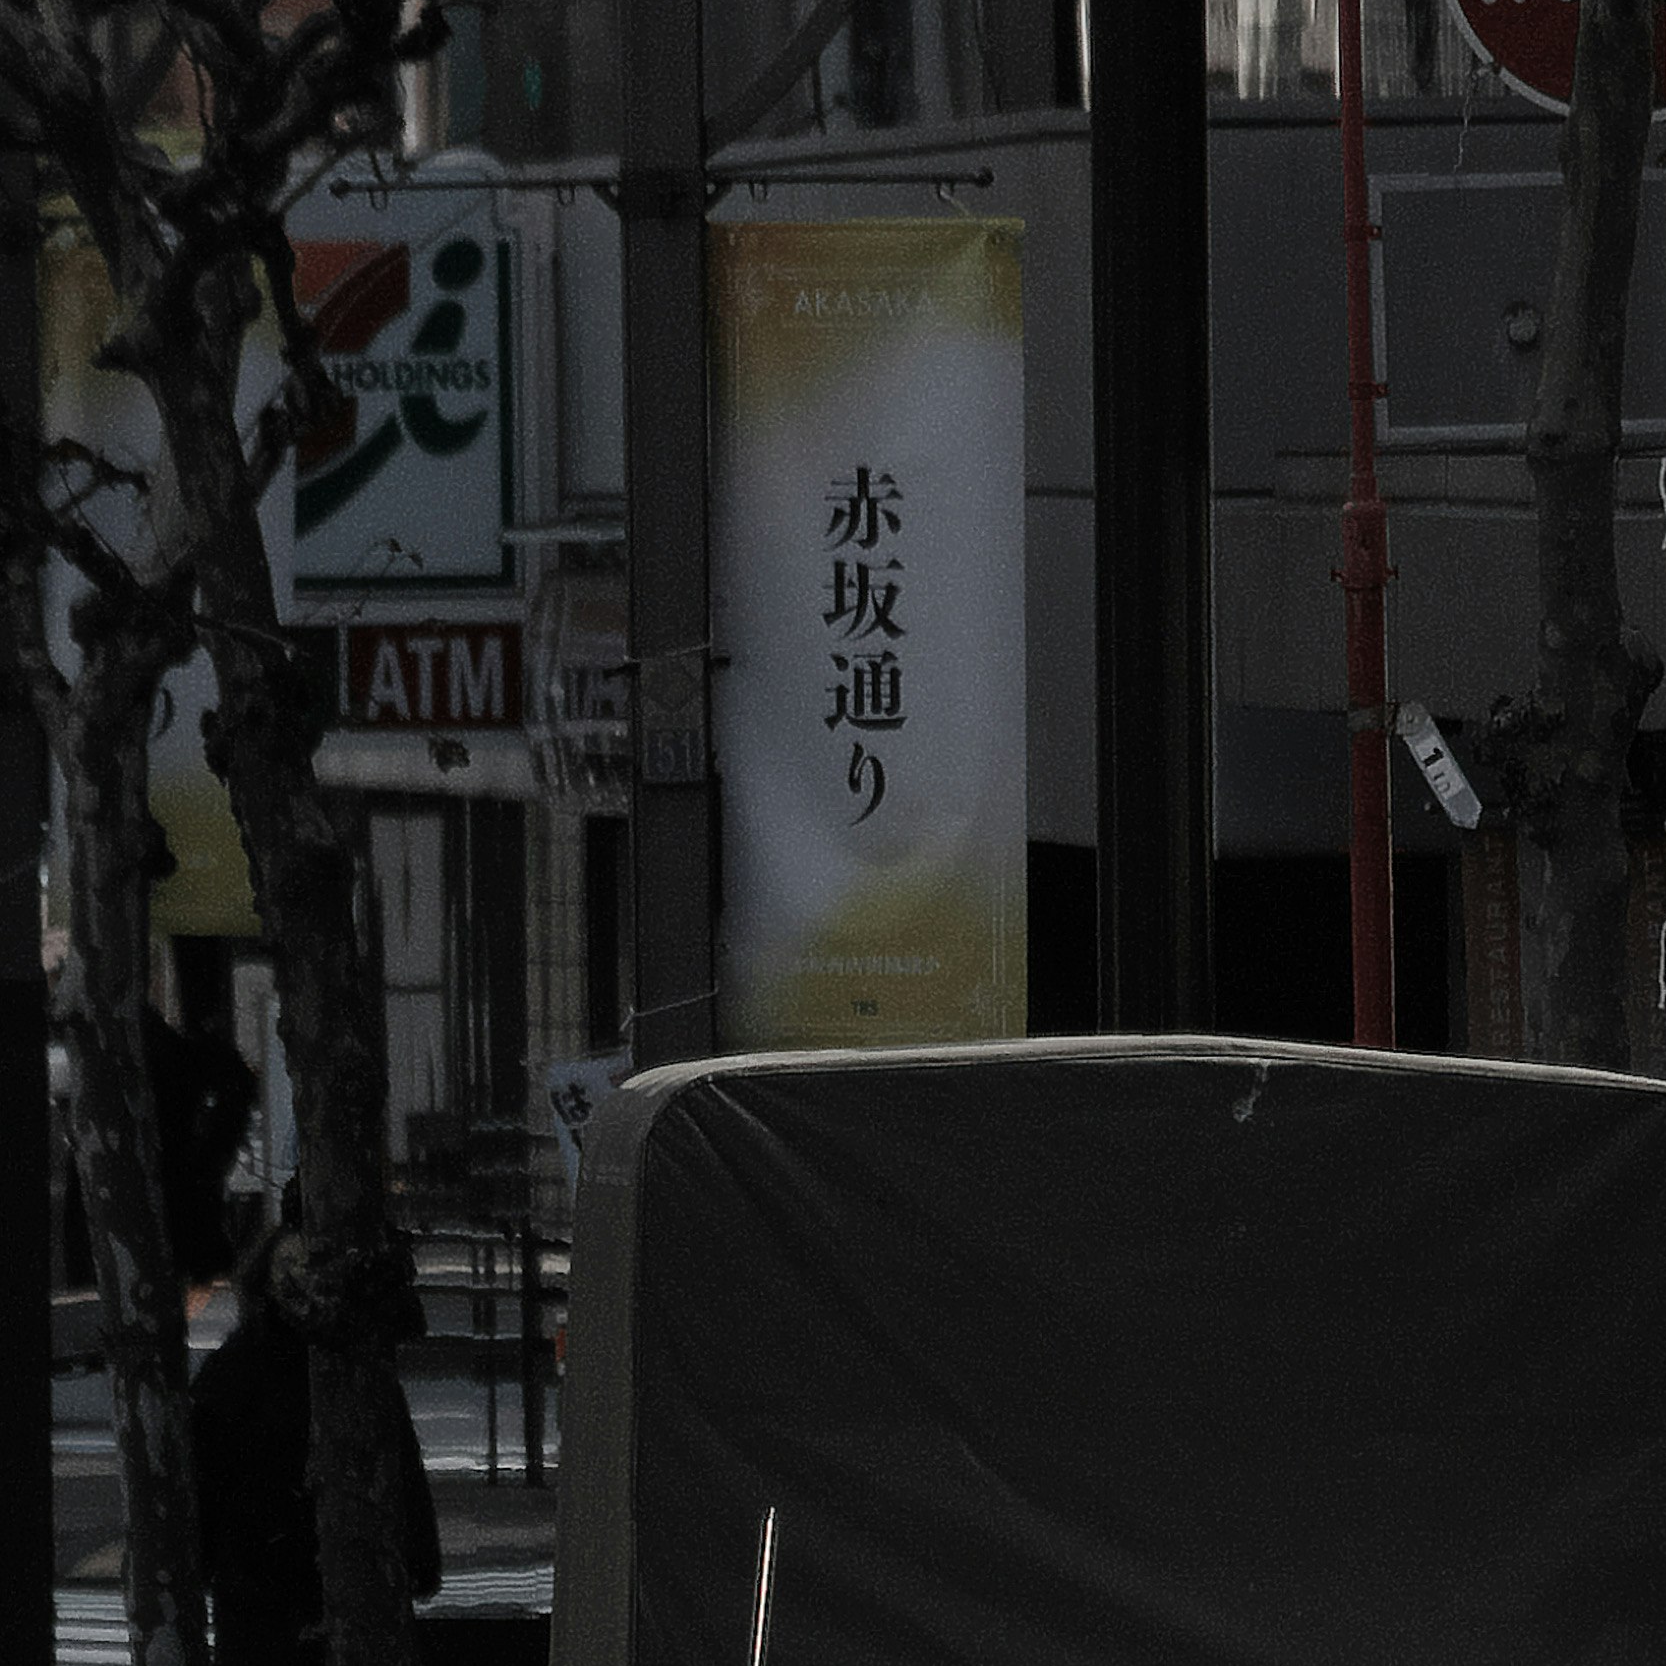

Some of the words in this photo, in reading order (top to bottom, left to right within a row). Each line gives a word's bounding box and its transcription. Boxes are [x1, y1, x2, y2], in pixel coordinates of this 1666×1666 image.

[333, 359, 492, 390] HOLDINGS
[367, 635, 506, 722] ATM
[822, 466, 908, 827] 赤坂通り
